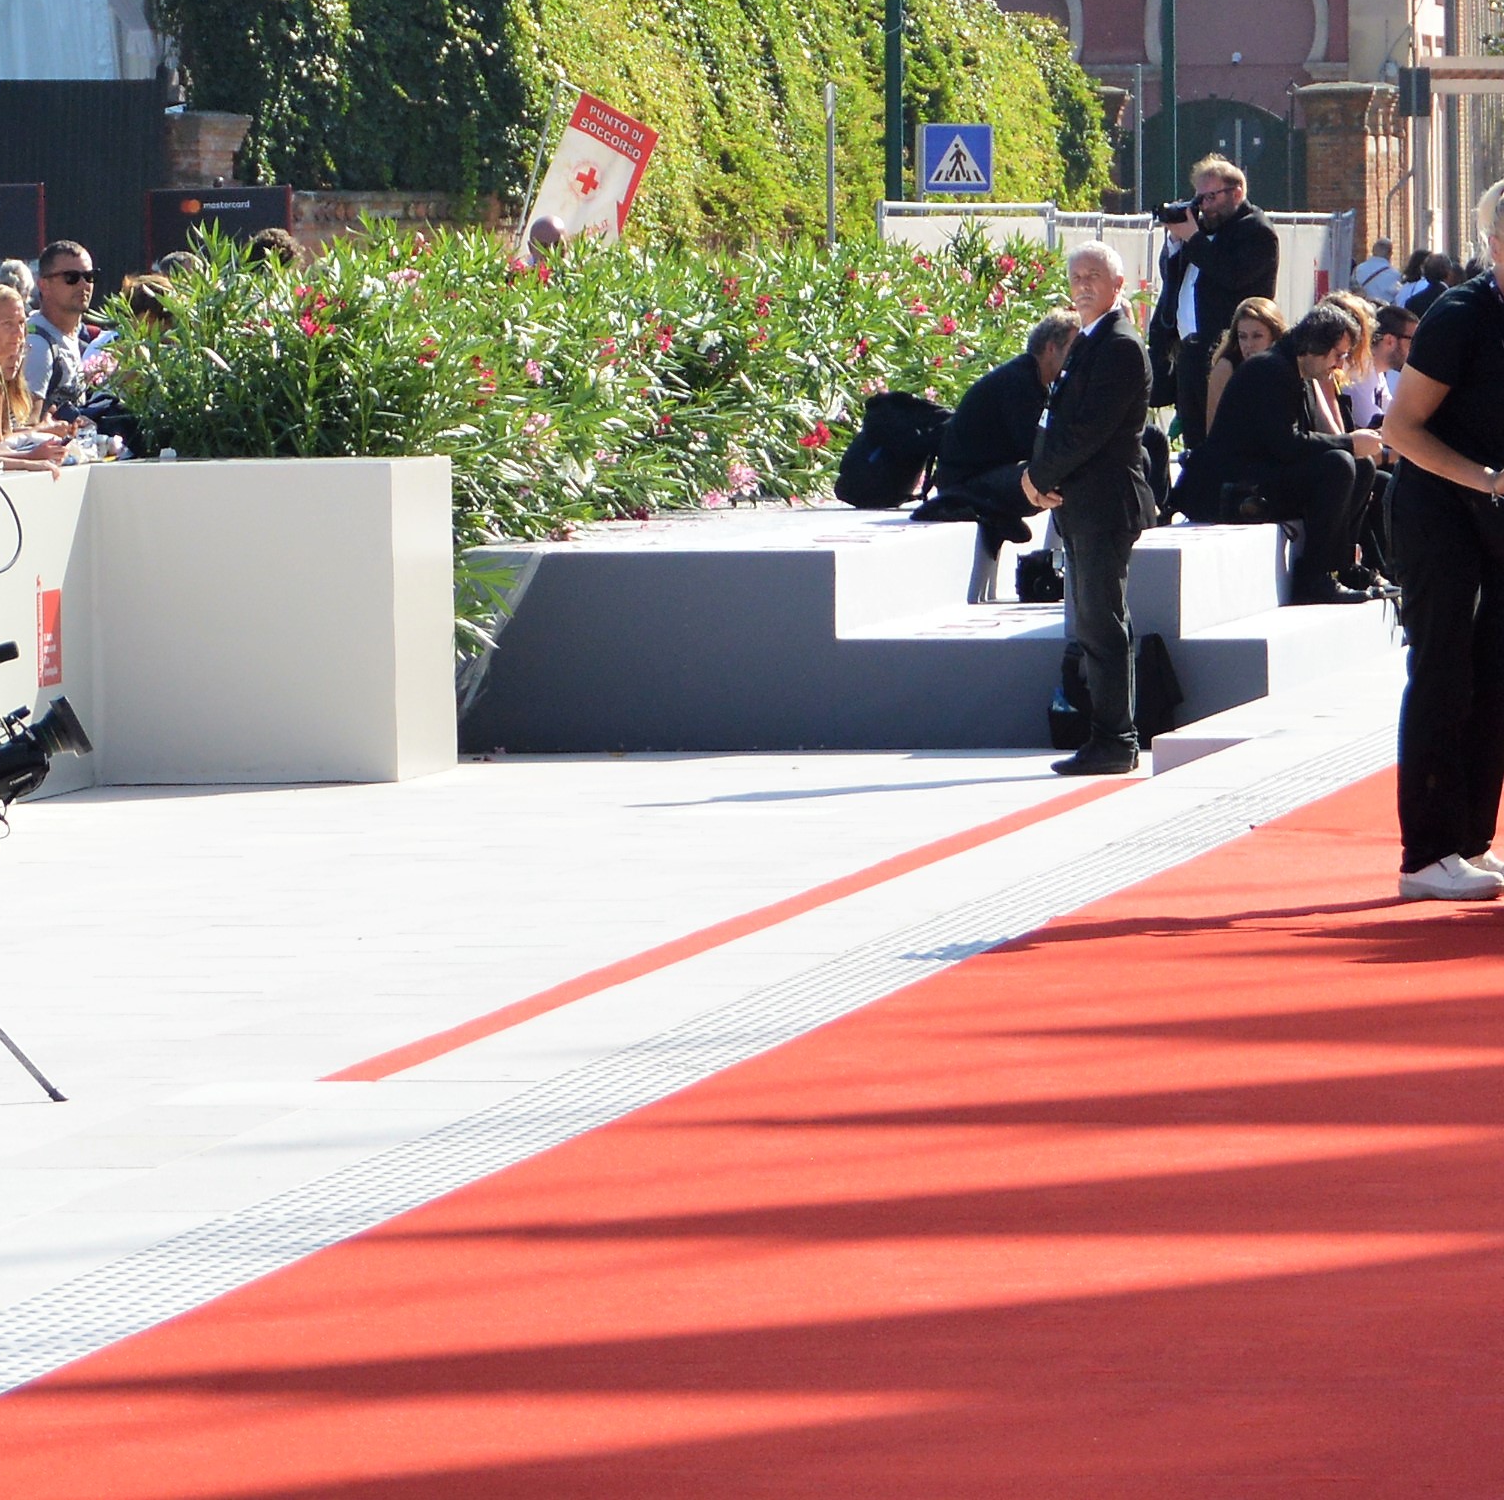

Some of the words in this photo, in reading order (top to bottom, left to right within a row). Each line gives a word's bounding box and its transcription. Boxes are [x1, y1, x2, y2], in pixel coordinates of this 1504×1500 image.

[579, 117, 642, 160] SOCCORSO
[589, 105, 630, 133] PUNTO
[631, 128, 645, 143] DI
[203, 200, 251, 209] mastercard
